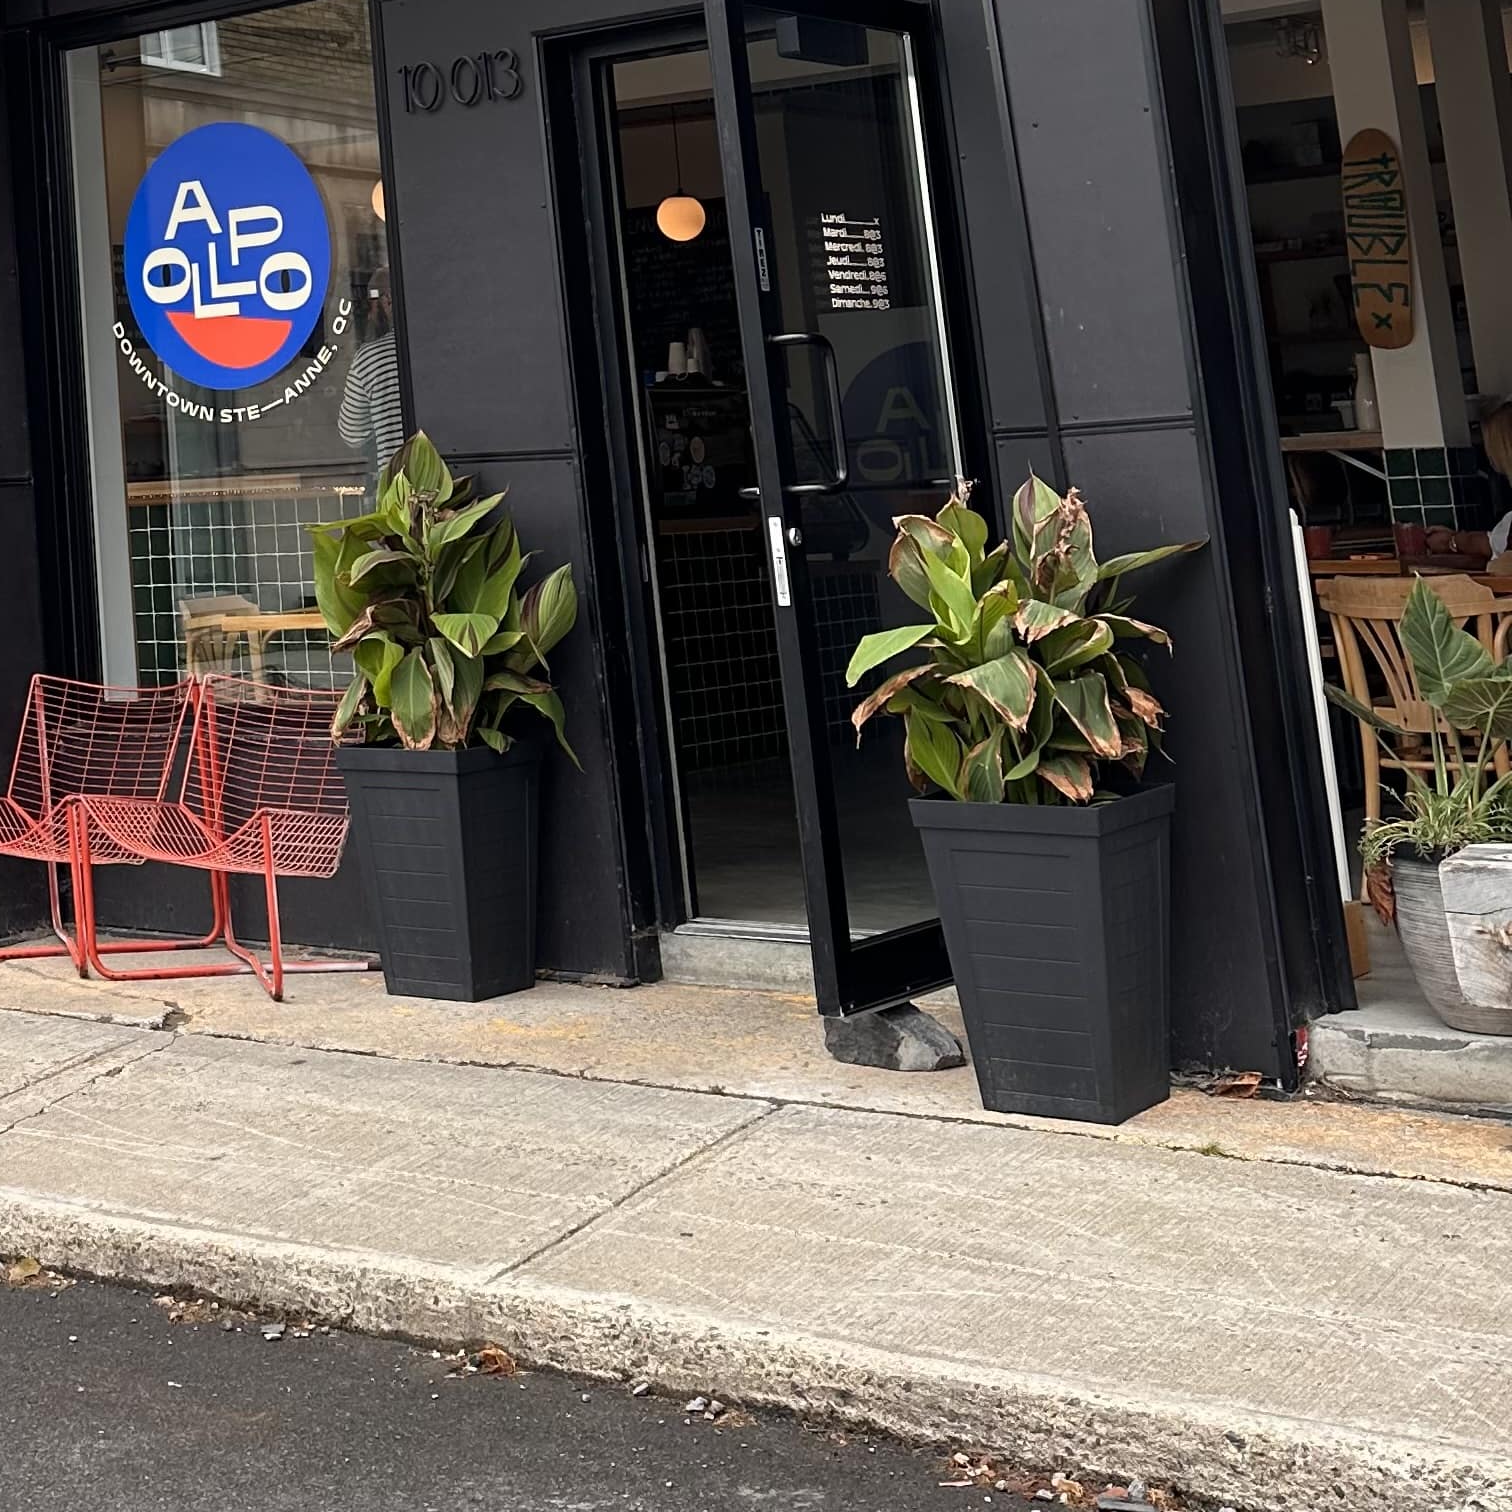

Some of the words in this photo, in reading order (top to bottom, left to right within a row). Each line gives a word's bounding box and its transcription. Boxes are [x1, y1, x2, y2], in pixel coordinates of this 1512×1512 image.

[142, 180, 313, 319] APOLLO
[112, 321, 215, 422] DOWNTOWN
[333, 298, 352, 335] QC
